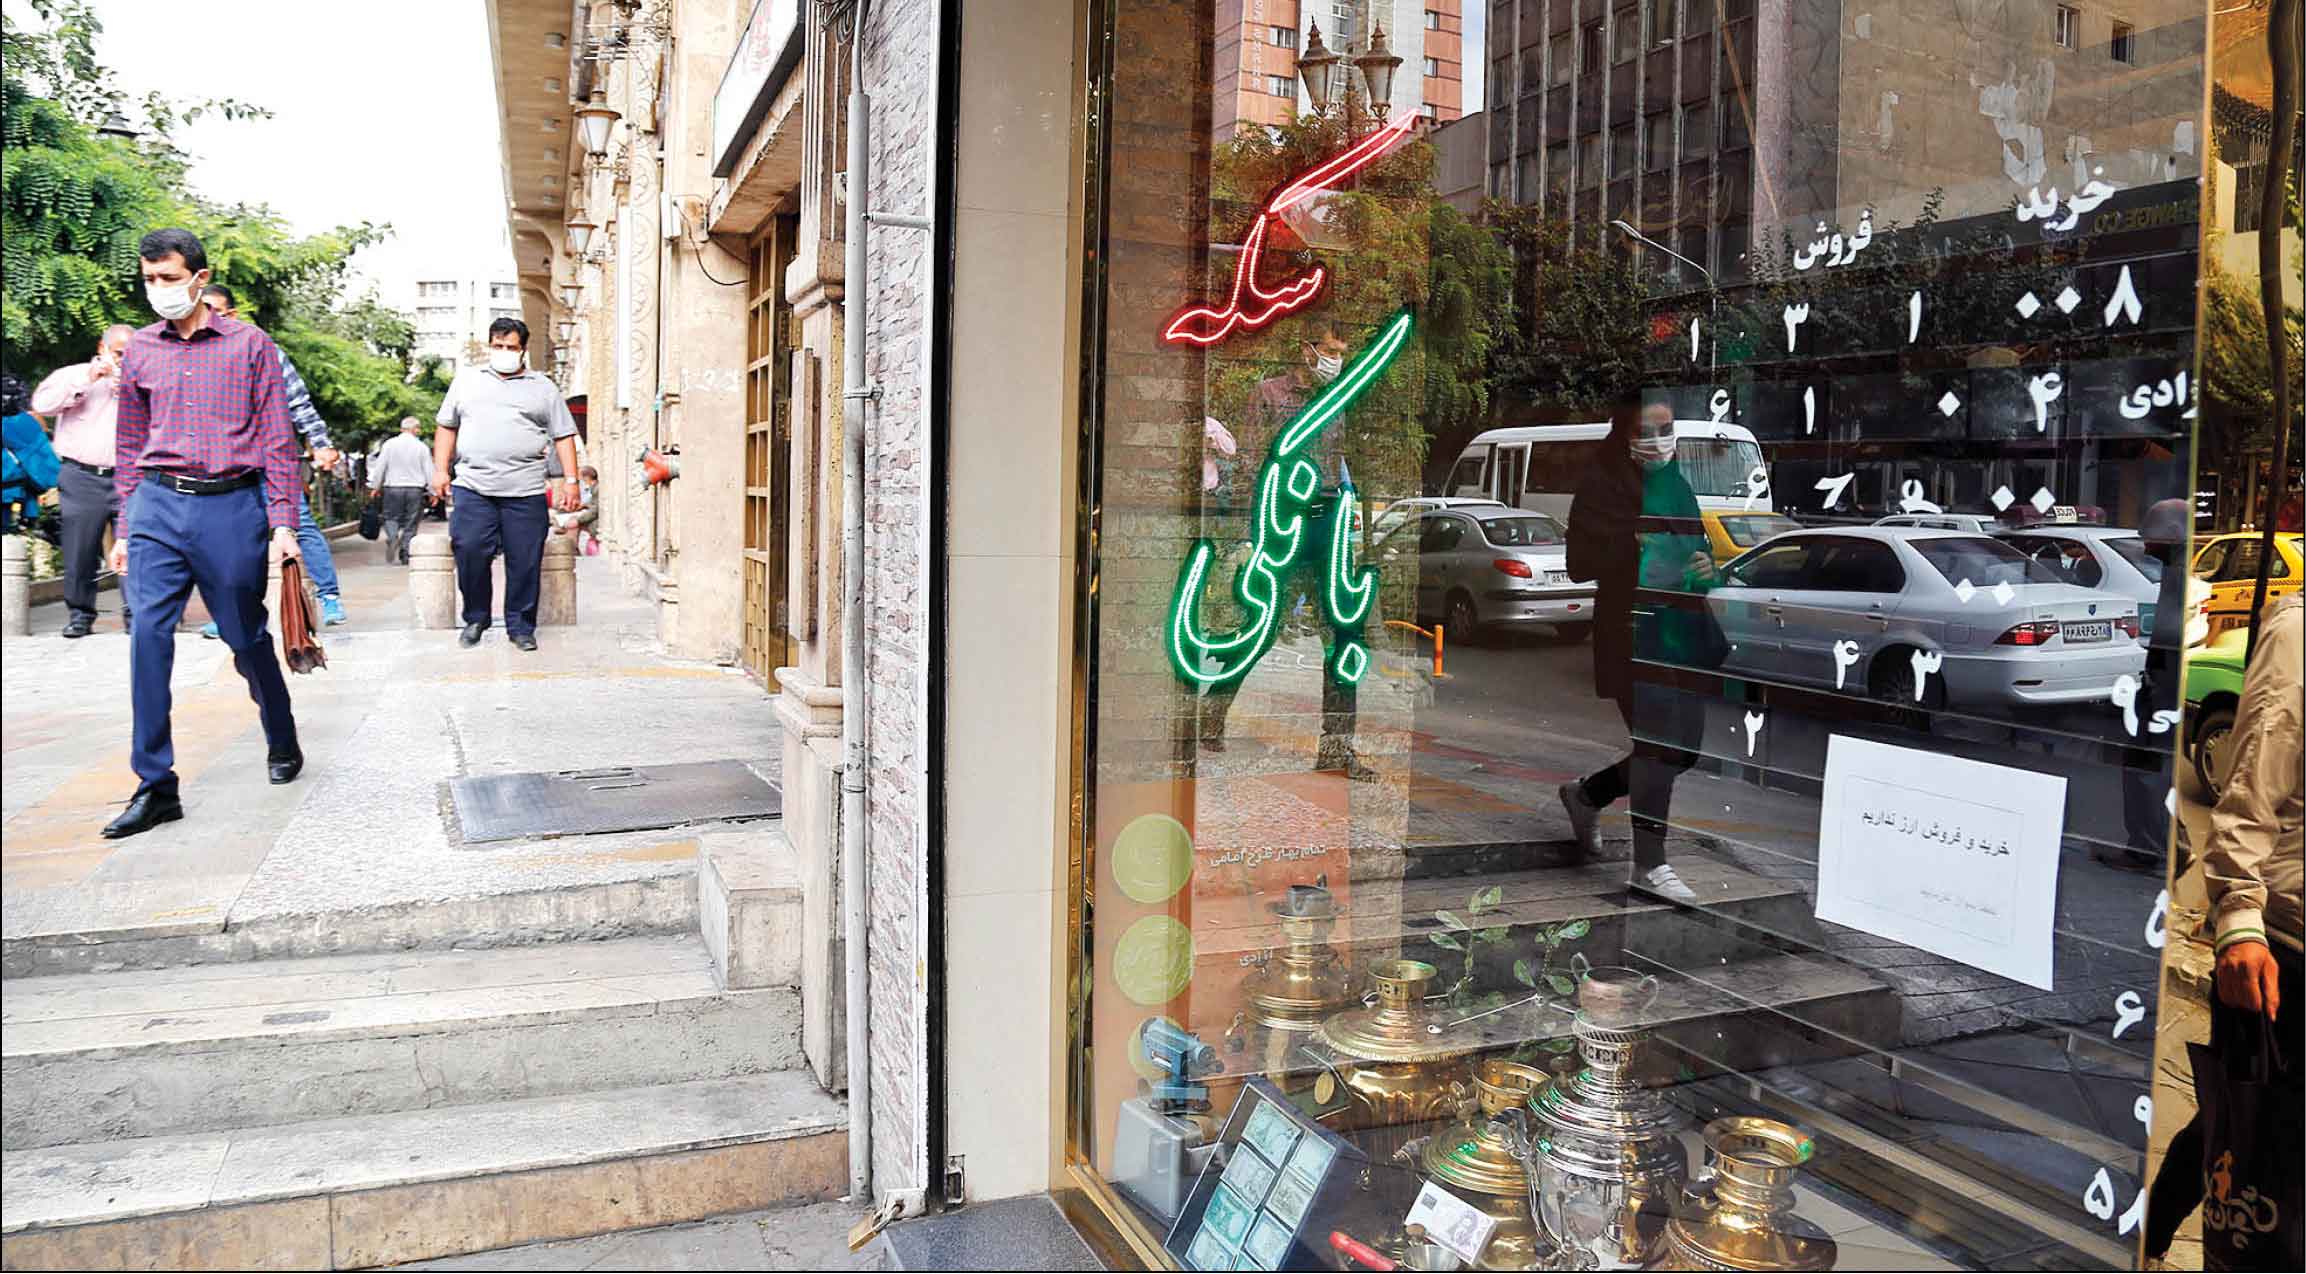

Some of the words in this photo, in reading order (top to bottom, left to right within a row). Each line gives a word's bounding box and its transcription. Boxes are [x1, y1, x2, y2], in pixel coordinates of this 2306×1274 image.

[2017, 166, 2116, 232] خرید
[1166, 108, 1421, 343] سکه
[1793, 210, 1872, 270] فروش
[2029, 372, 2064, 432] ۴
[1833, 640, 1859, 690] ۴
[1910, 649, 1942, 701] ۳
[1862, 810, 1896, 826] نداریم
[1899, 818, 1918, 834] ارز
[1922, 823, 1960, 844] فروش
[1965, 838, 1974, 849] و
[1979, 841, 2010, 856] خرید
[2115, 990, 2144, 1039] ۶
